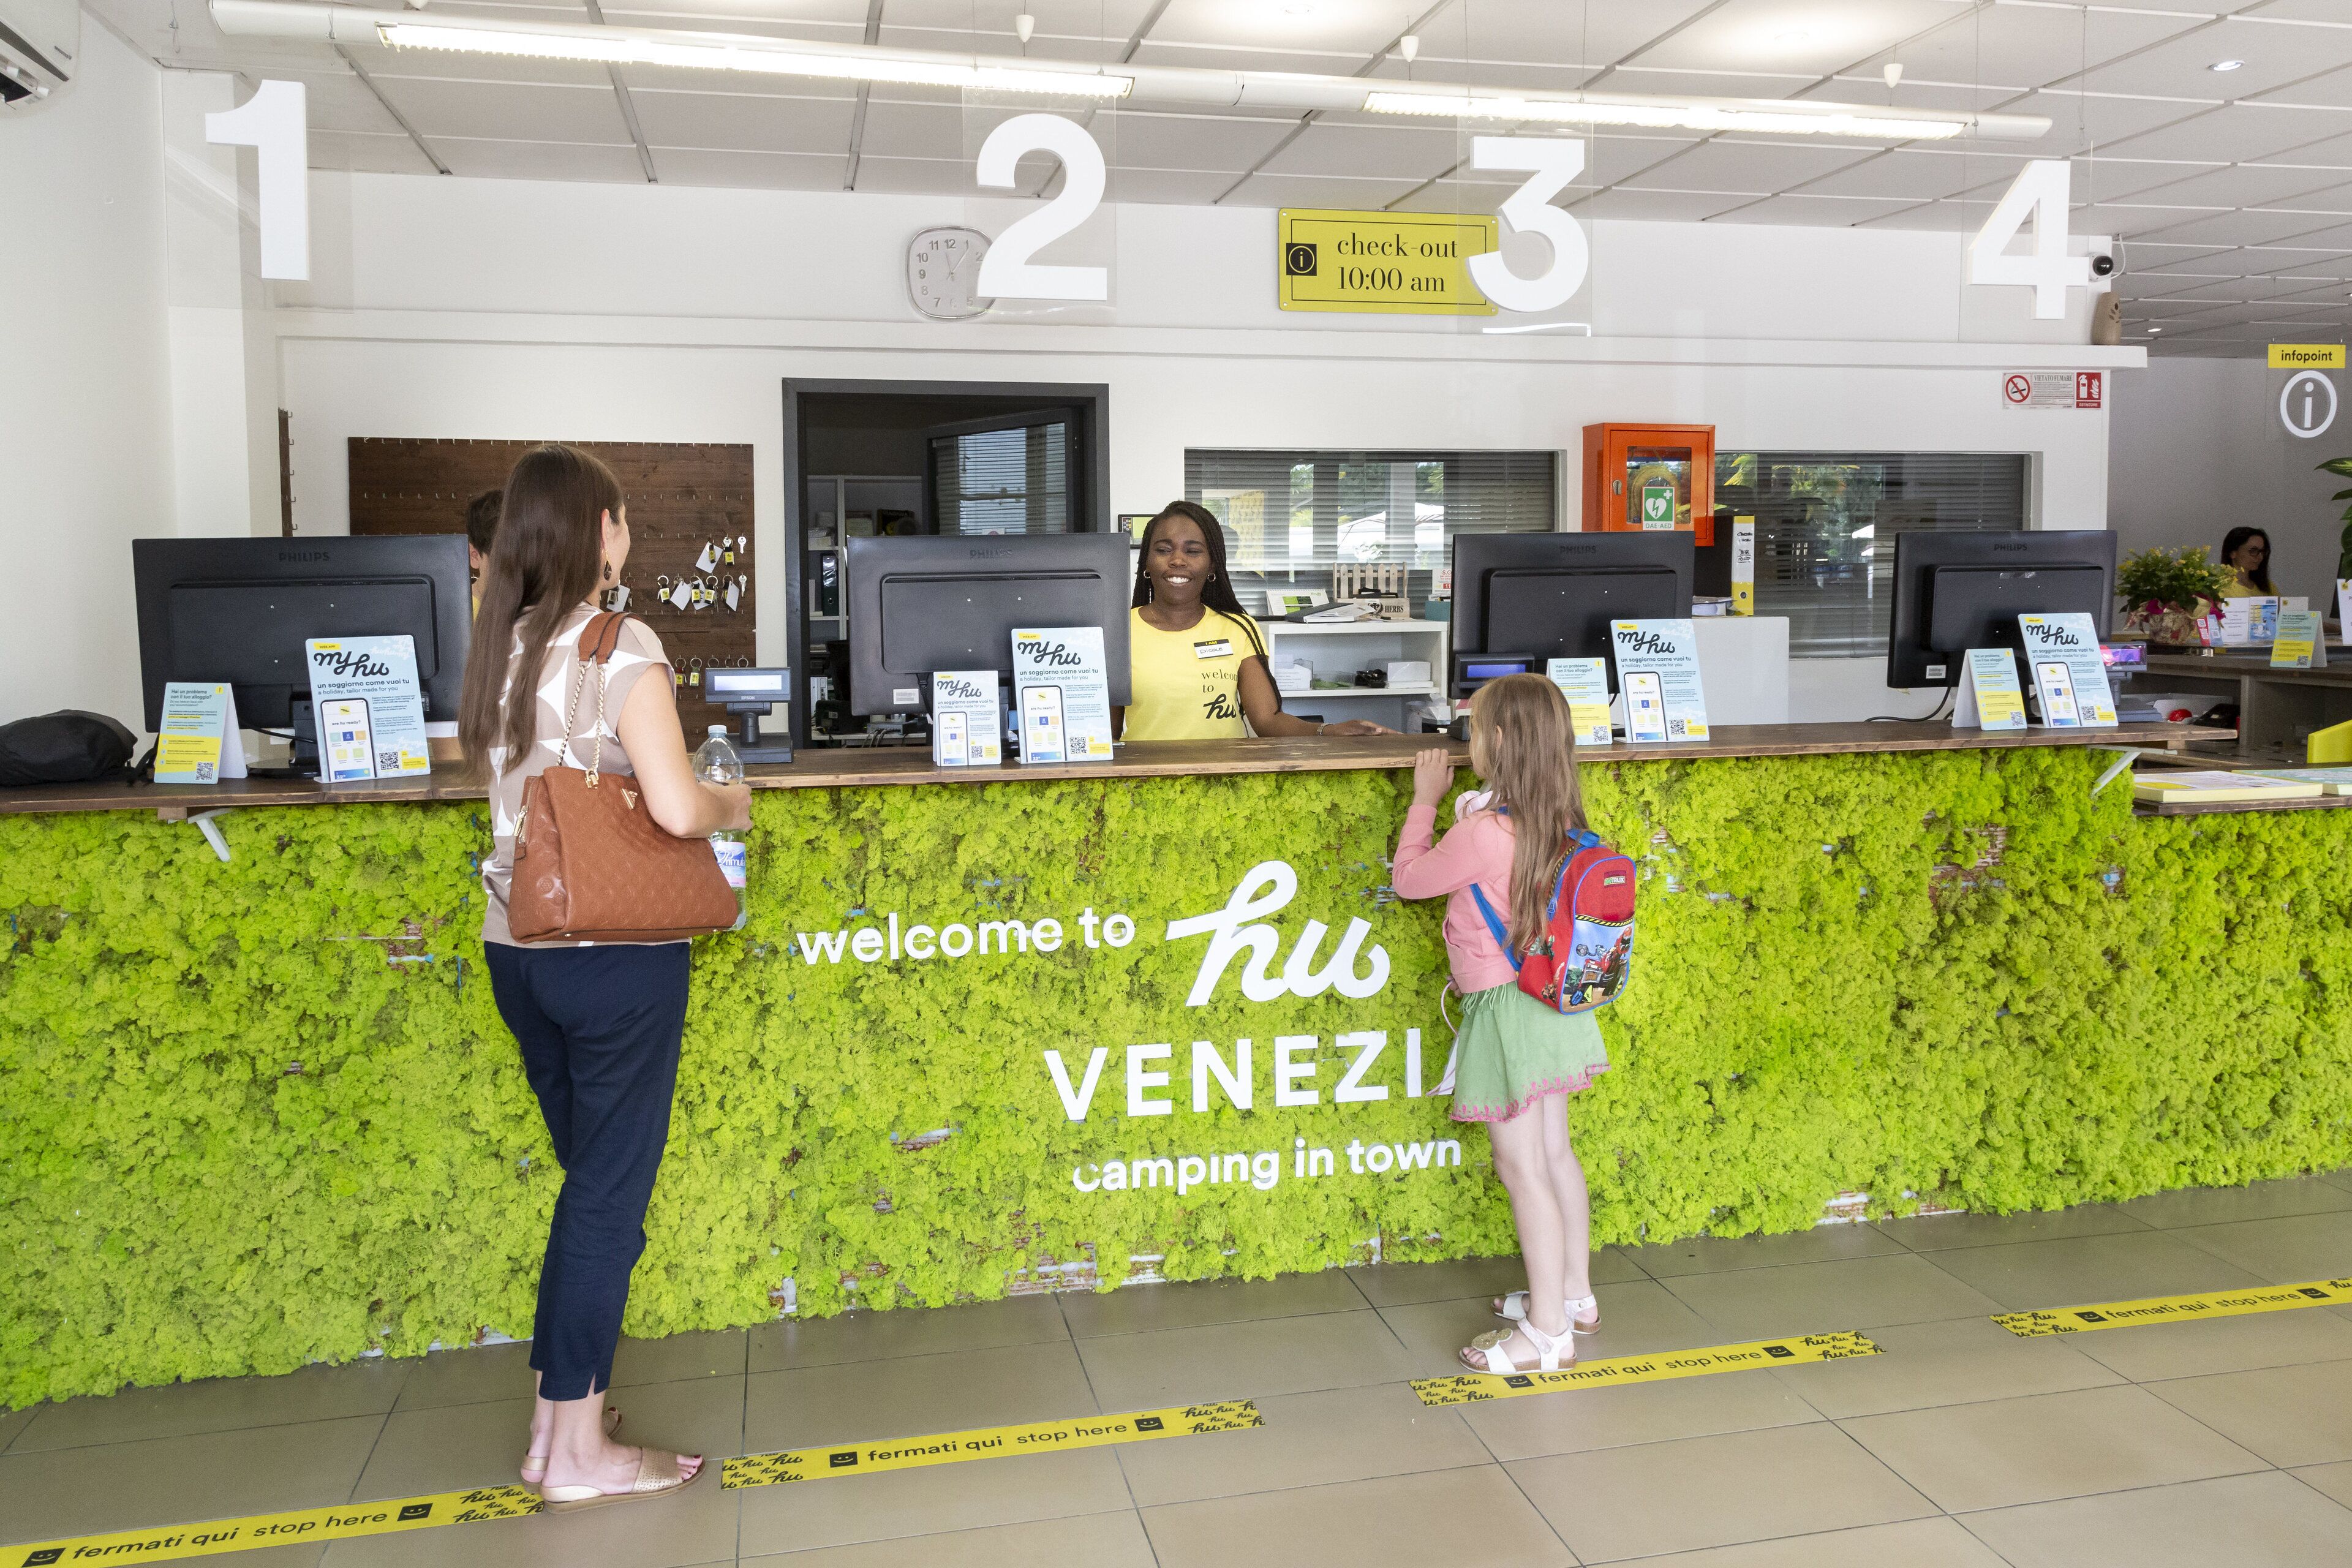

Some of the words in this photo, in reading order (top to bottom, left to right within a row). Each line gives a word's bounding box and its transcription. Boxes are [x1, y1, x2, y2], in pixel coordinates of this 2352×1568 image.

[205, 79, 309, 281] 1
[976, 113, 1108, 301] 2
[1469, 136, 1589, 312] 3
[929, 240, 940, 251] 11
[944, 238, 957, 250] 12
[1336, 232, 1458, 258] check-out
[1967, 160, 2089, 320] 4
[916, 252, 929, 263] 10
[919, 269, 926, 279] 9
[1336, 266, 1403, 291] 10:00
[1410, 274, 1446, 292] am
[921, 285, 929, 296] 8
[933, 297, 941, 307] 7
[2281, 350, 2333, 364] infopoint
[277, 550, 331, 563] PHILIPS
[1559, 545, 1597, 555] PHILIPS
[1994, 543, 2028, 551] PHILIPS
[1202, 684, 1214, 693] to
[796, 911, 1063, 966] welcome
[1077, 907, 1137, 949] to
[1166, 860, 1391, 1008] hu
[1072, 1150, 1281, 1196] camping
[1294, 1137, 1335, 1178] in
[1346, 1137, 1462, 1174] town
[2107, 1302, 2177, 1319] fermati
[2179, 1299, 2211, 1313] qui
[2216, 1295, 2257, 1309] stop
[2261, 1289, 2302, 1303] here
[1537, 1368, 1618, 1385] fermati
[1623, 1361, 1656, 1377] qui
[1665, 1355, 1711, 1371] stop
[1716, 1348, 1762, 1363] here
[867, 1439, 958, 1463] fermati
[965, 1434, 1004, 1453] qui
[1017, 1428, 1068, 1446] stop
[1076, 1420, 1128, 1437] here
[72, 1534, 186, 1561] fermati
[192, 1527, 240, 1548] qui
[253, 1520, 316, 1539] stop
[325, 1509, 388, 1529] here
